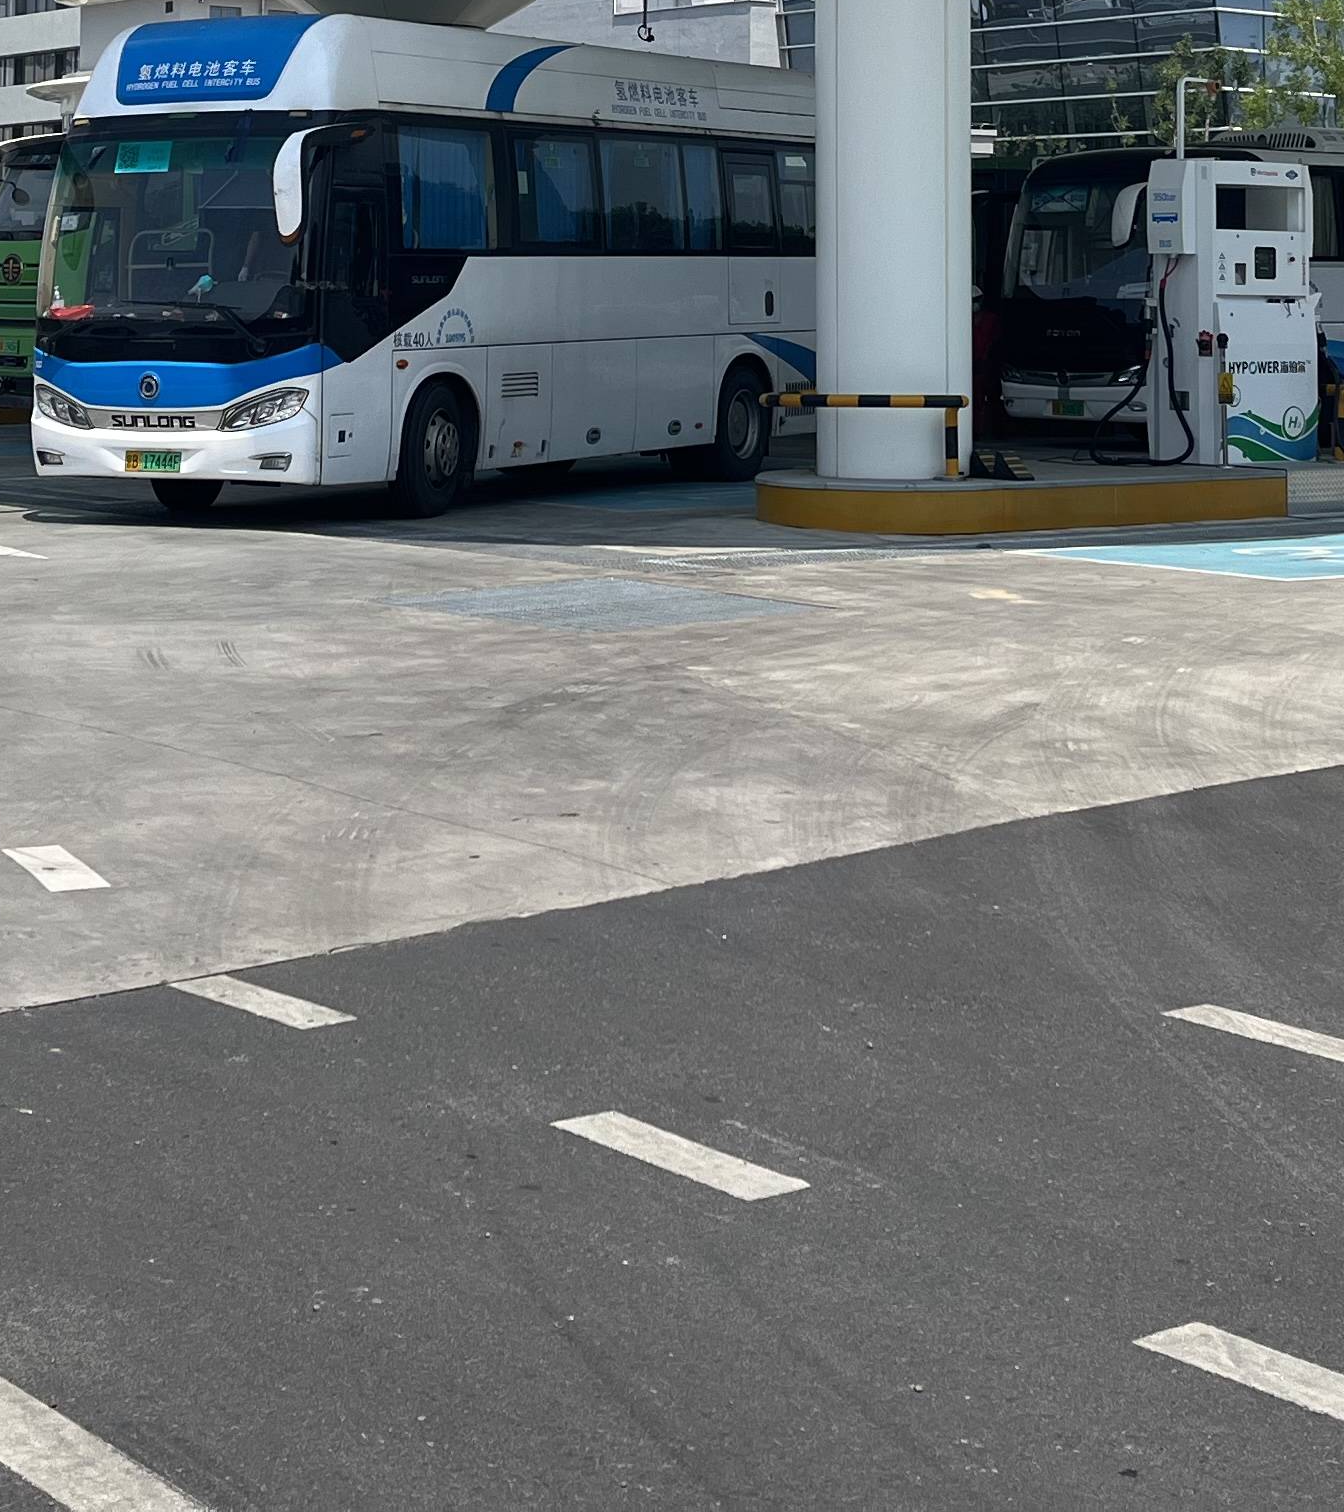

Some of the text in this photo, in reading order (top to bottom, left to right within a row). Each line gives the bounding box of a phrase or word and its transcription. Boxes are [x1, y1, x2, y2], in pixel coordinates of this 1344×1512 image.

[138, 59, 257, 81] 氢燃料电池客车
[161, 79, 179, 89] FUEL
[182, 78, 199, 88] CELL
[204, 77, 244, 88] INTERCITY
[246, 77, 262, 87] BUS
[1228, 360, 1280, 375] HYPOWER
[111, 414, 196, 429] SUNLONG
